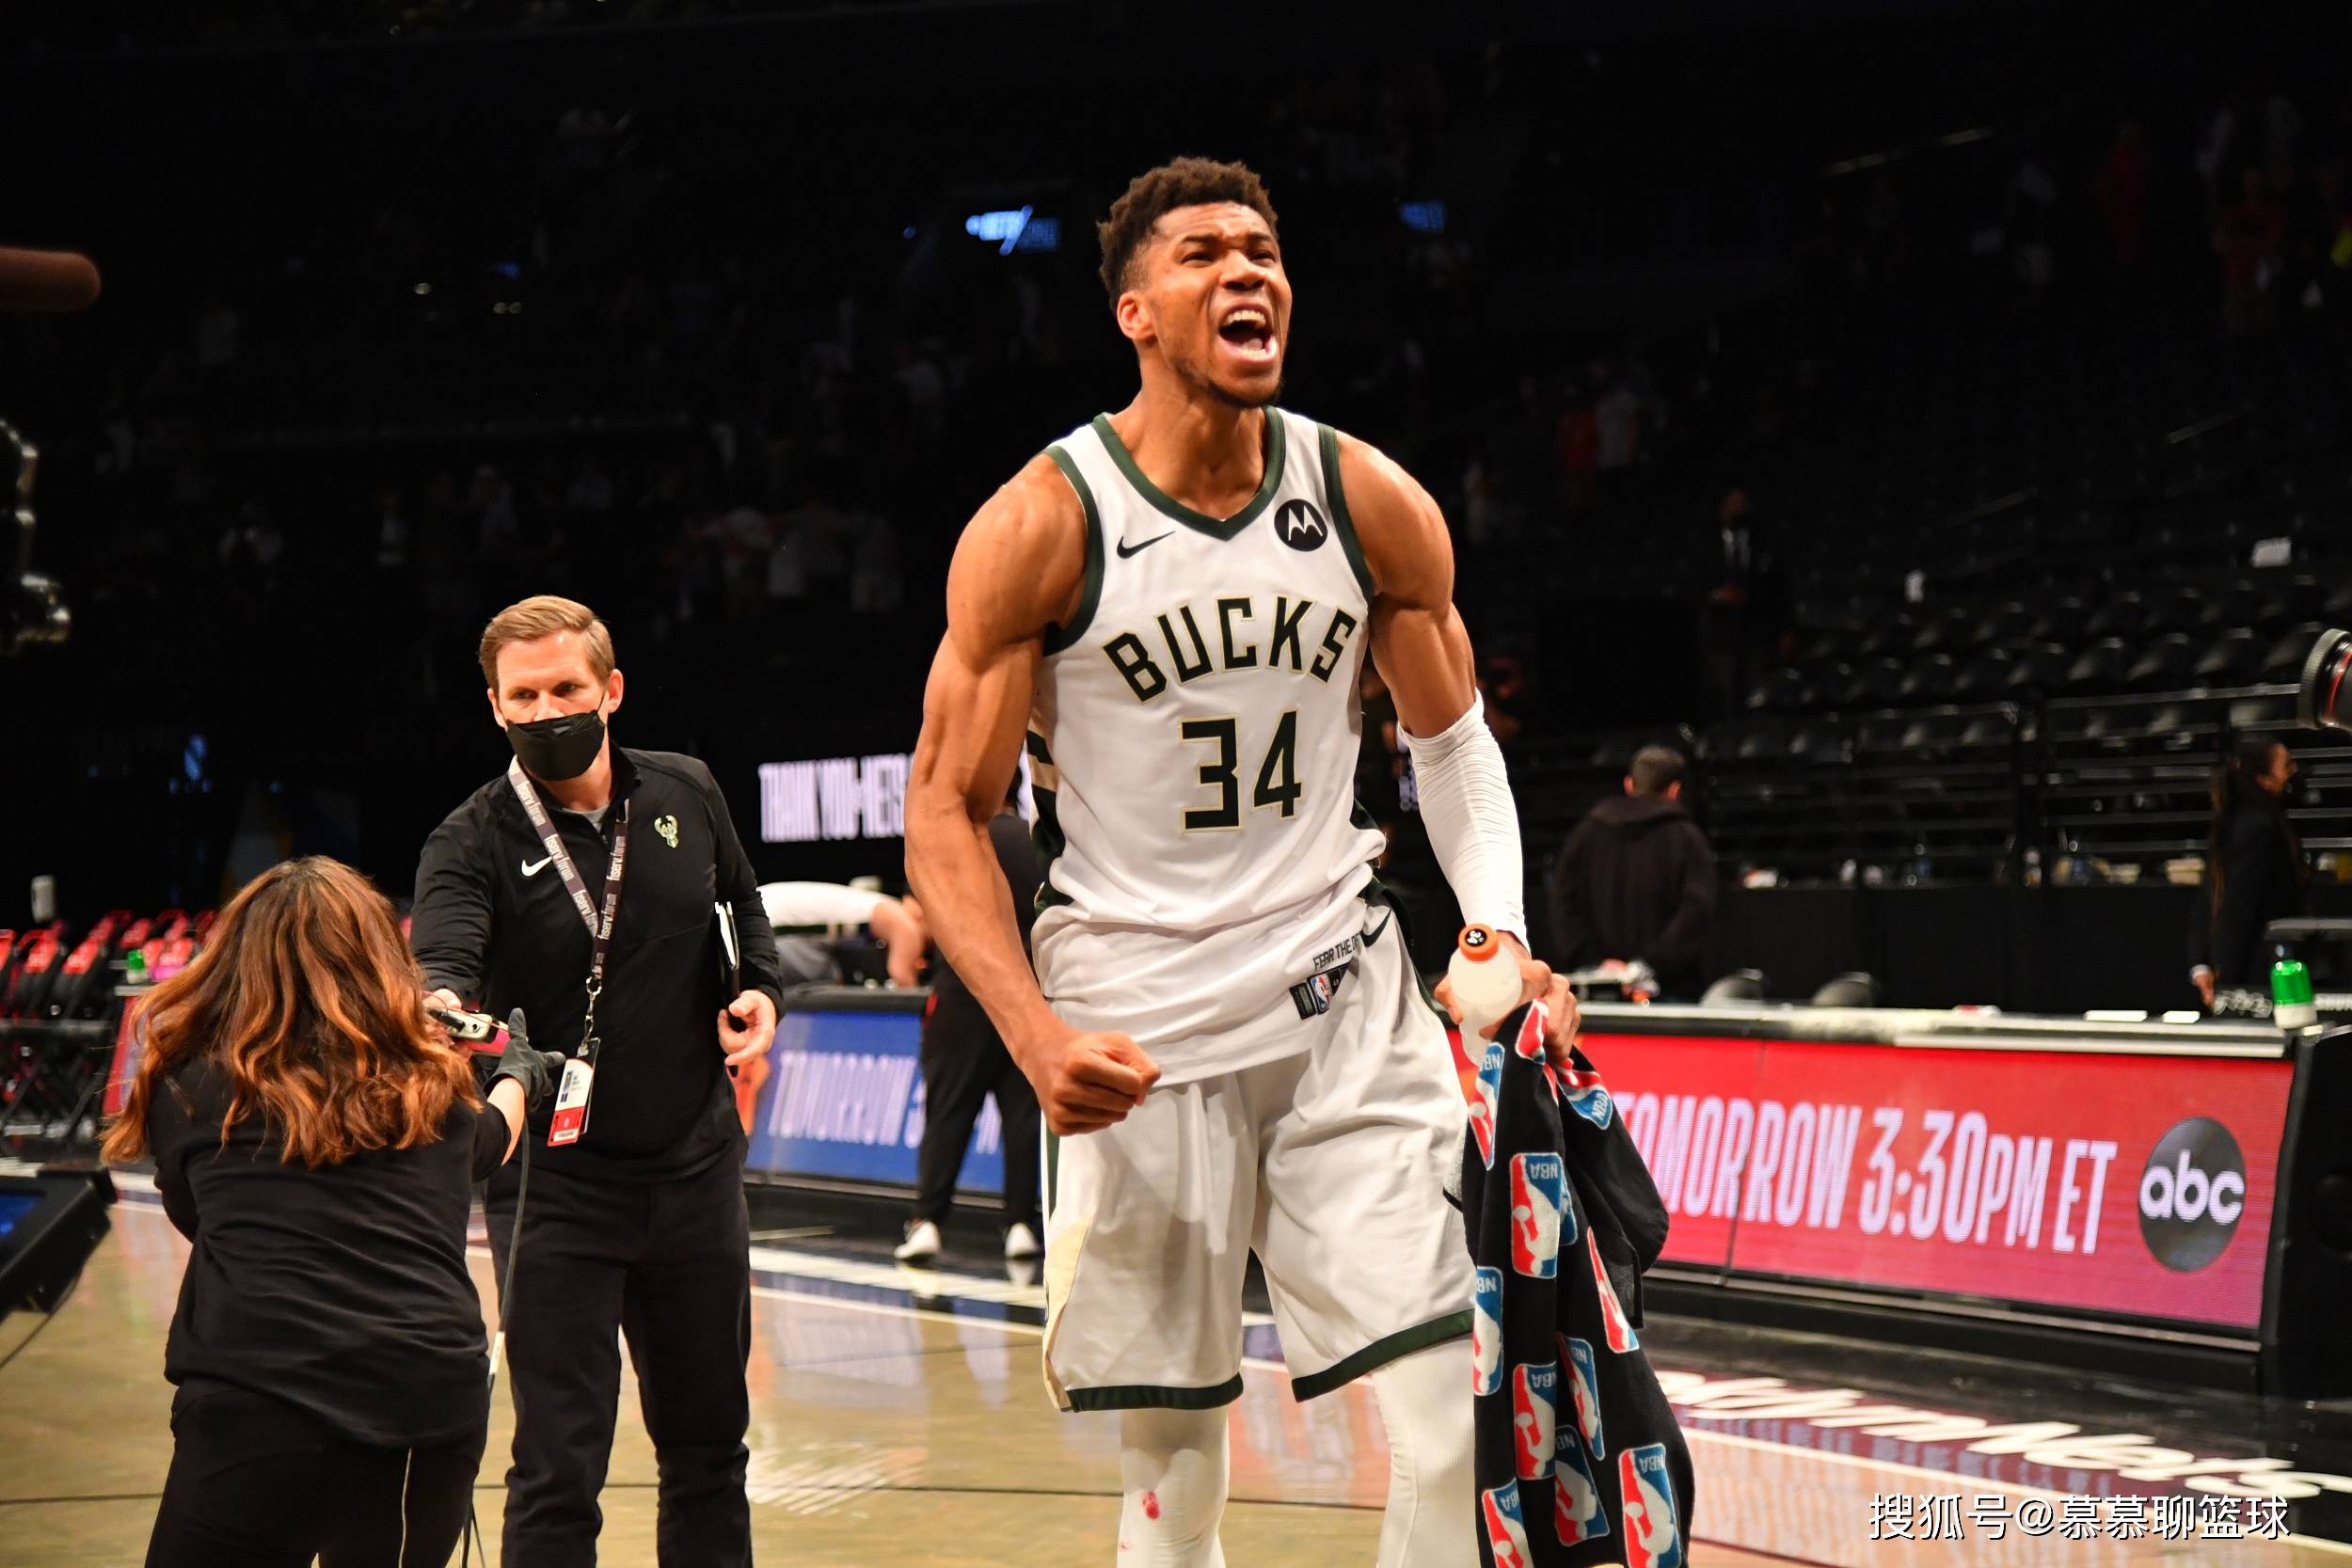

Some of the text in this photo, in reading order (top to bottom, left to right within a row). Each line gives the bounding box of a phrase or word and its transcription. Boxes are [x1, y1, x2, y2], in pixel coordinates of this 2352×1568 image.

[1103, 594, 1359, 705] BUCKS
[1179, 707, 1303, 834] 34
[1313, 948, 1334, 971] FEAR
[1334, 939, 1352, 959] THE
[1530, 1163, 1559, 1180] NBA
[1859, 1108, 2054, 1249] 3:30PM
[2053, 1138, 2118, 1255] ET
[2139, 1150, 2247, 1225] abc
